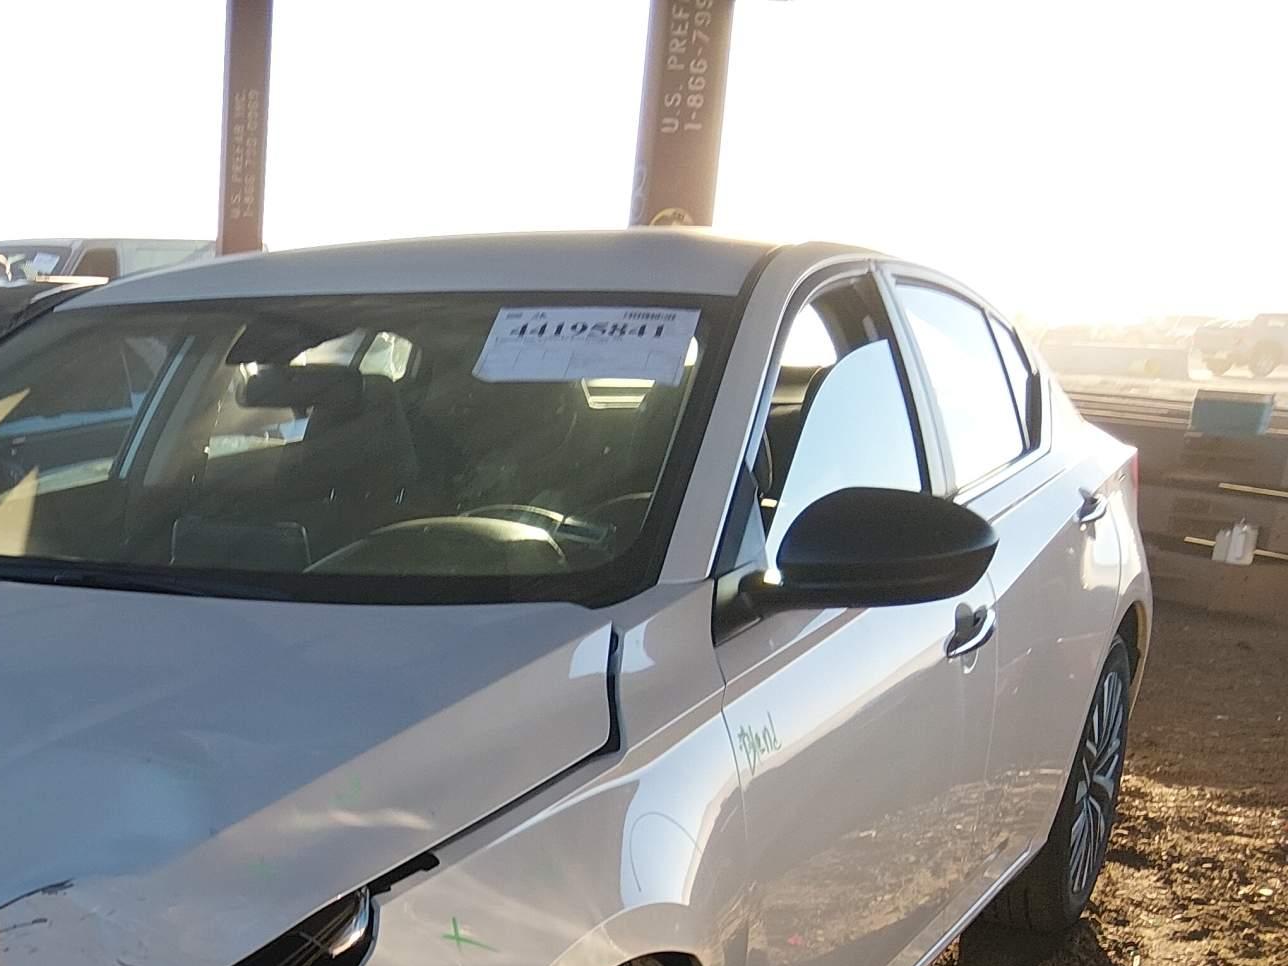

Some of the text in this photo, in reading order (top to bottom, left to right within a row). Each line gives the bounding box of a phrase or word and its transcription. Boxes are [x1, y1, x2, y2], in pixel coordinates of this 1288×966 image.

[661, 0, 691, 134] U.S. PREF
[509, 320, 665, 338] 44195841
